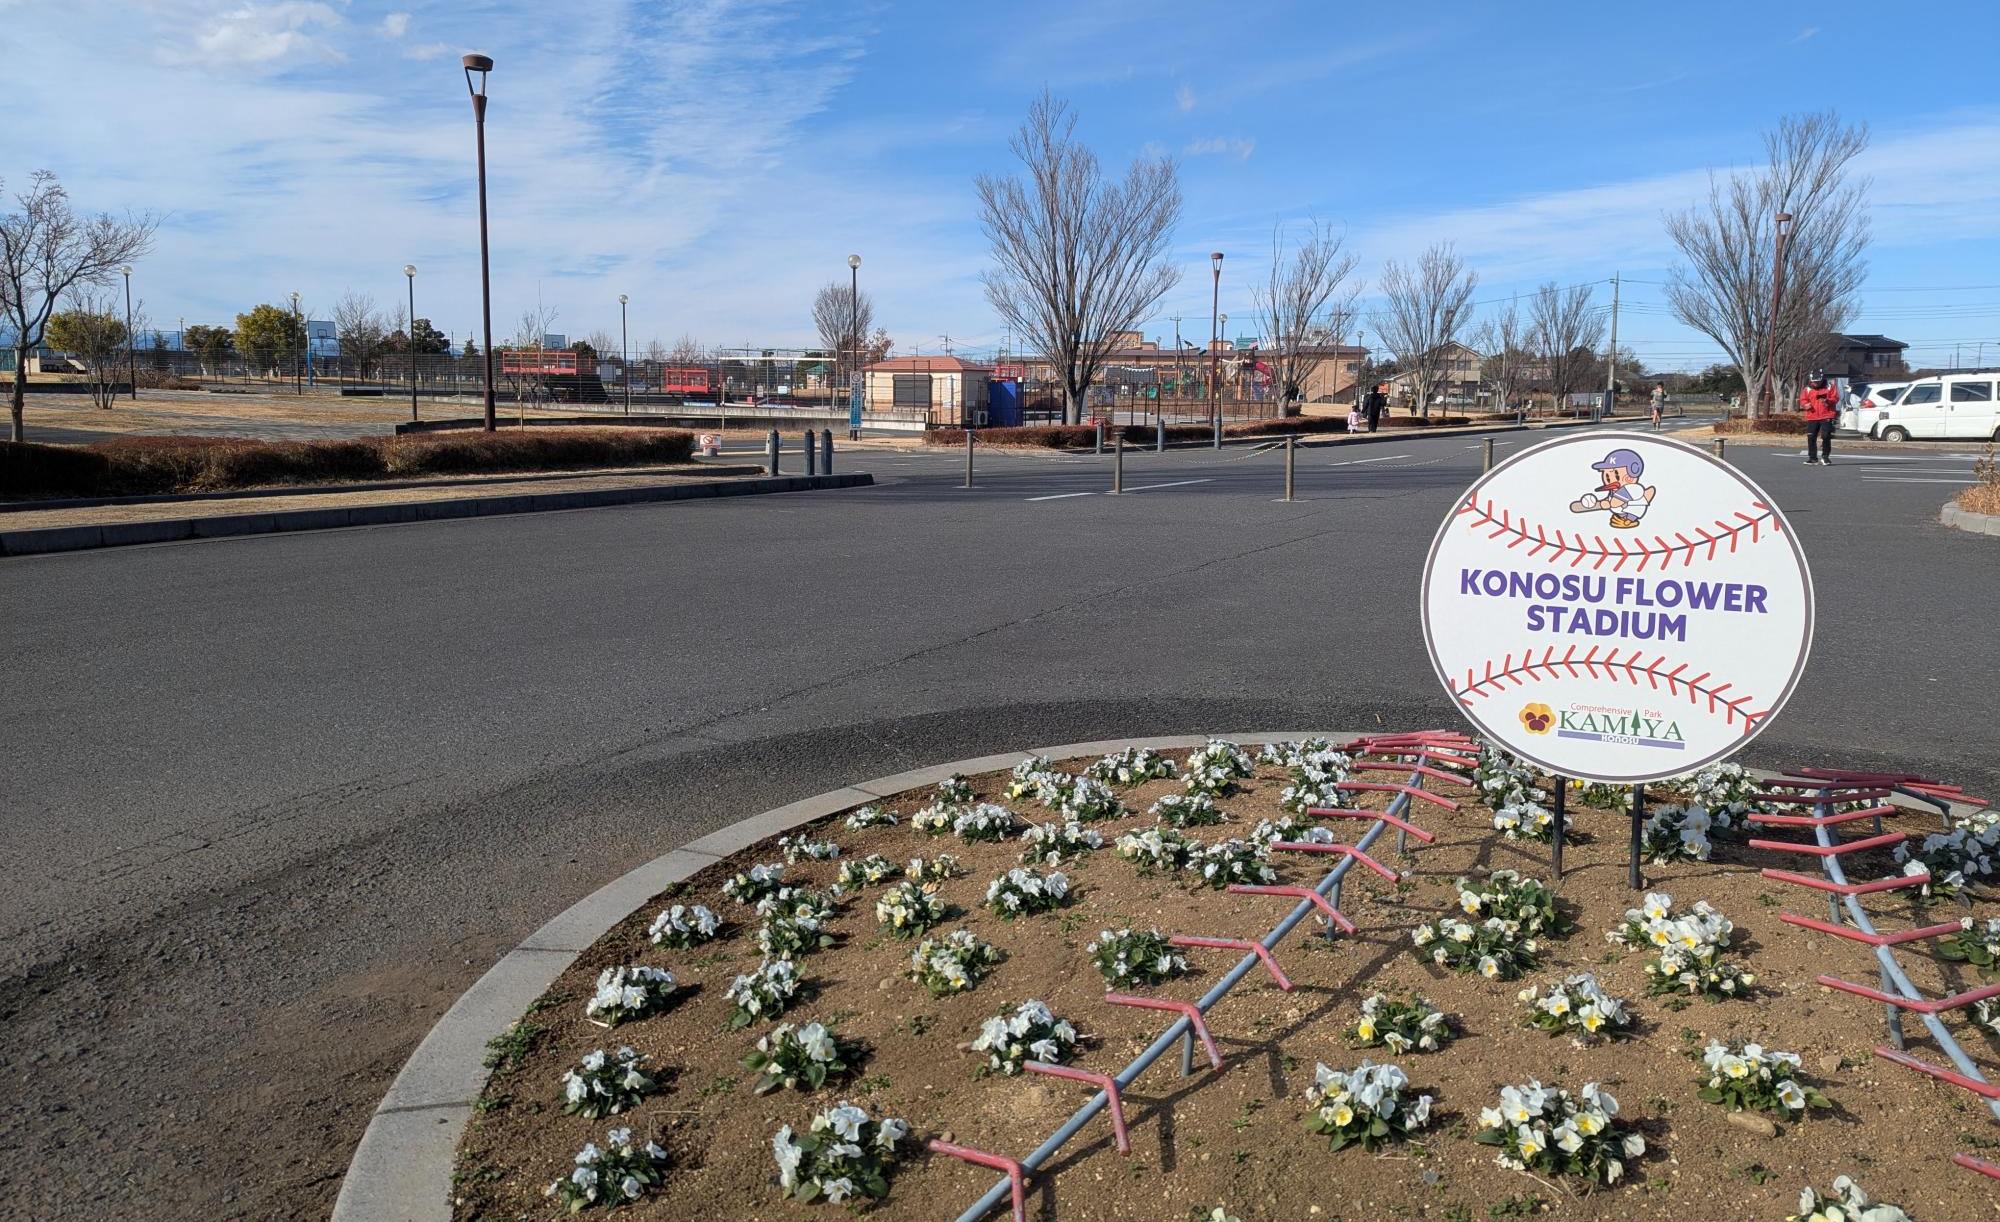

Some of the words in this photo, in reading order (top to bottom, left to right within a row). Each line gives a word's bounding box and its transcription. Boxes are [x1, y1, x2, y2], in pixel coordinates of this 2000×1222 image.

[1609, 456, 1617, 465] K
[1461, 569, 1606, 603] KONOSU
[1616, 577, 1768, 614] FLOWER
[1527, 605, 1687, 641] STADIUM
[1571, 702, 1633, 716] Comprehensive
[1644, 709, 1663, 719] Park
